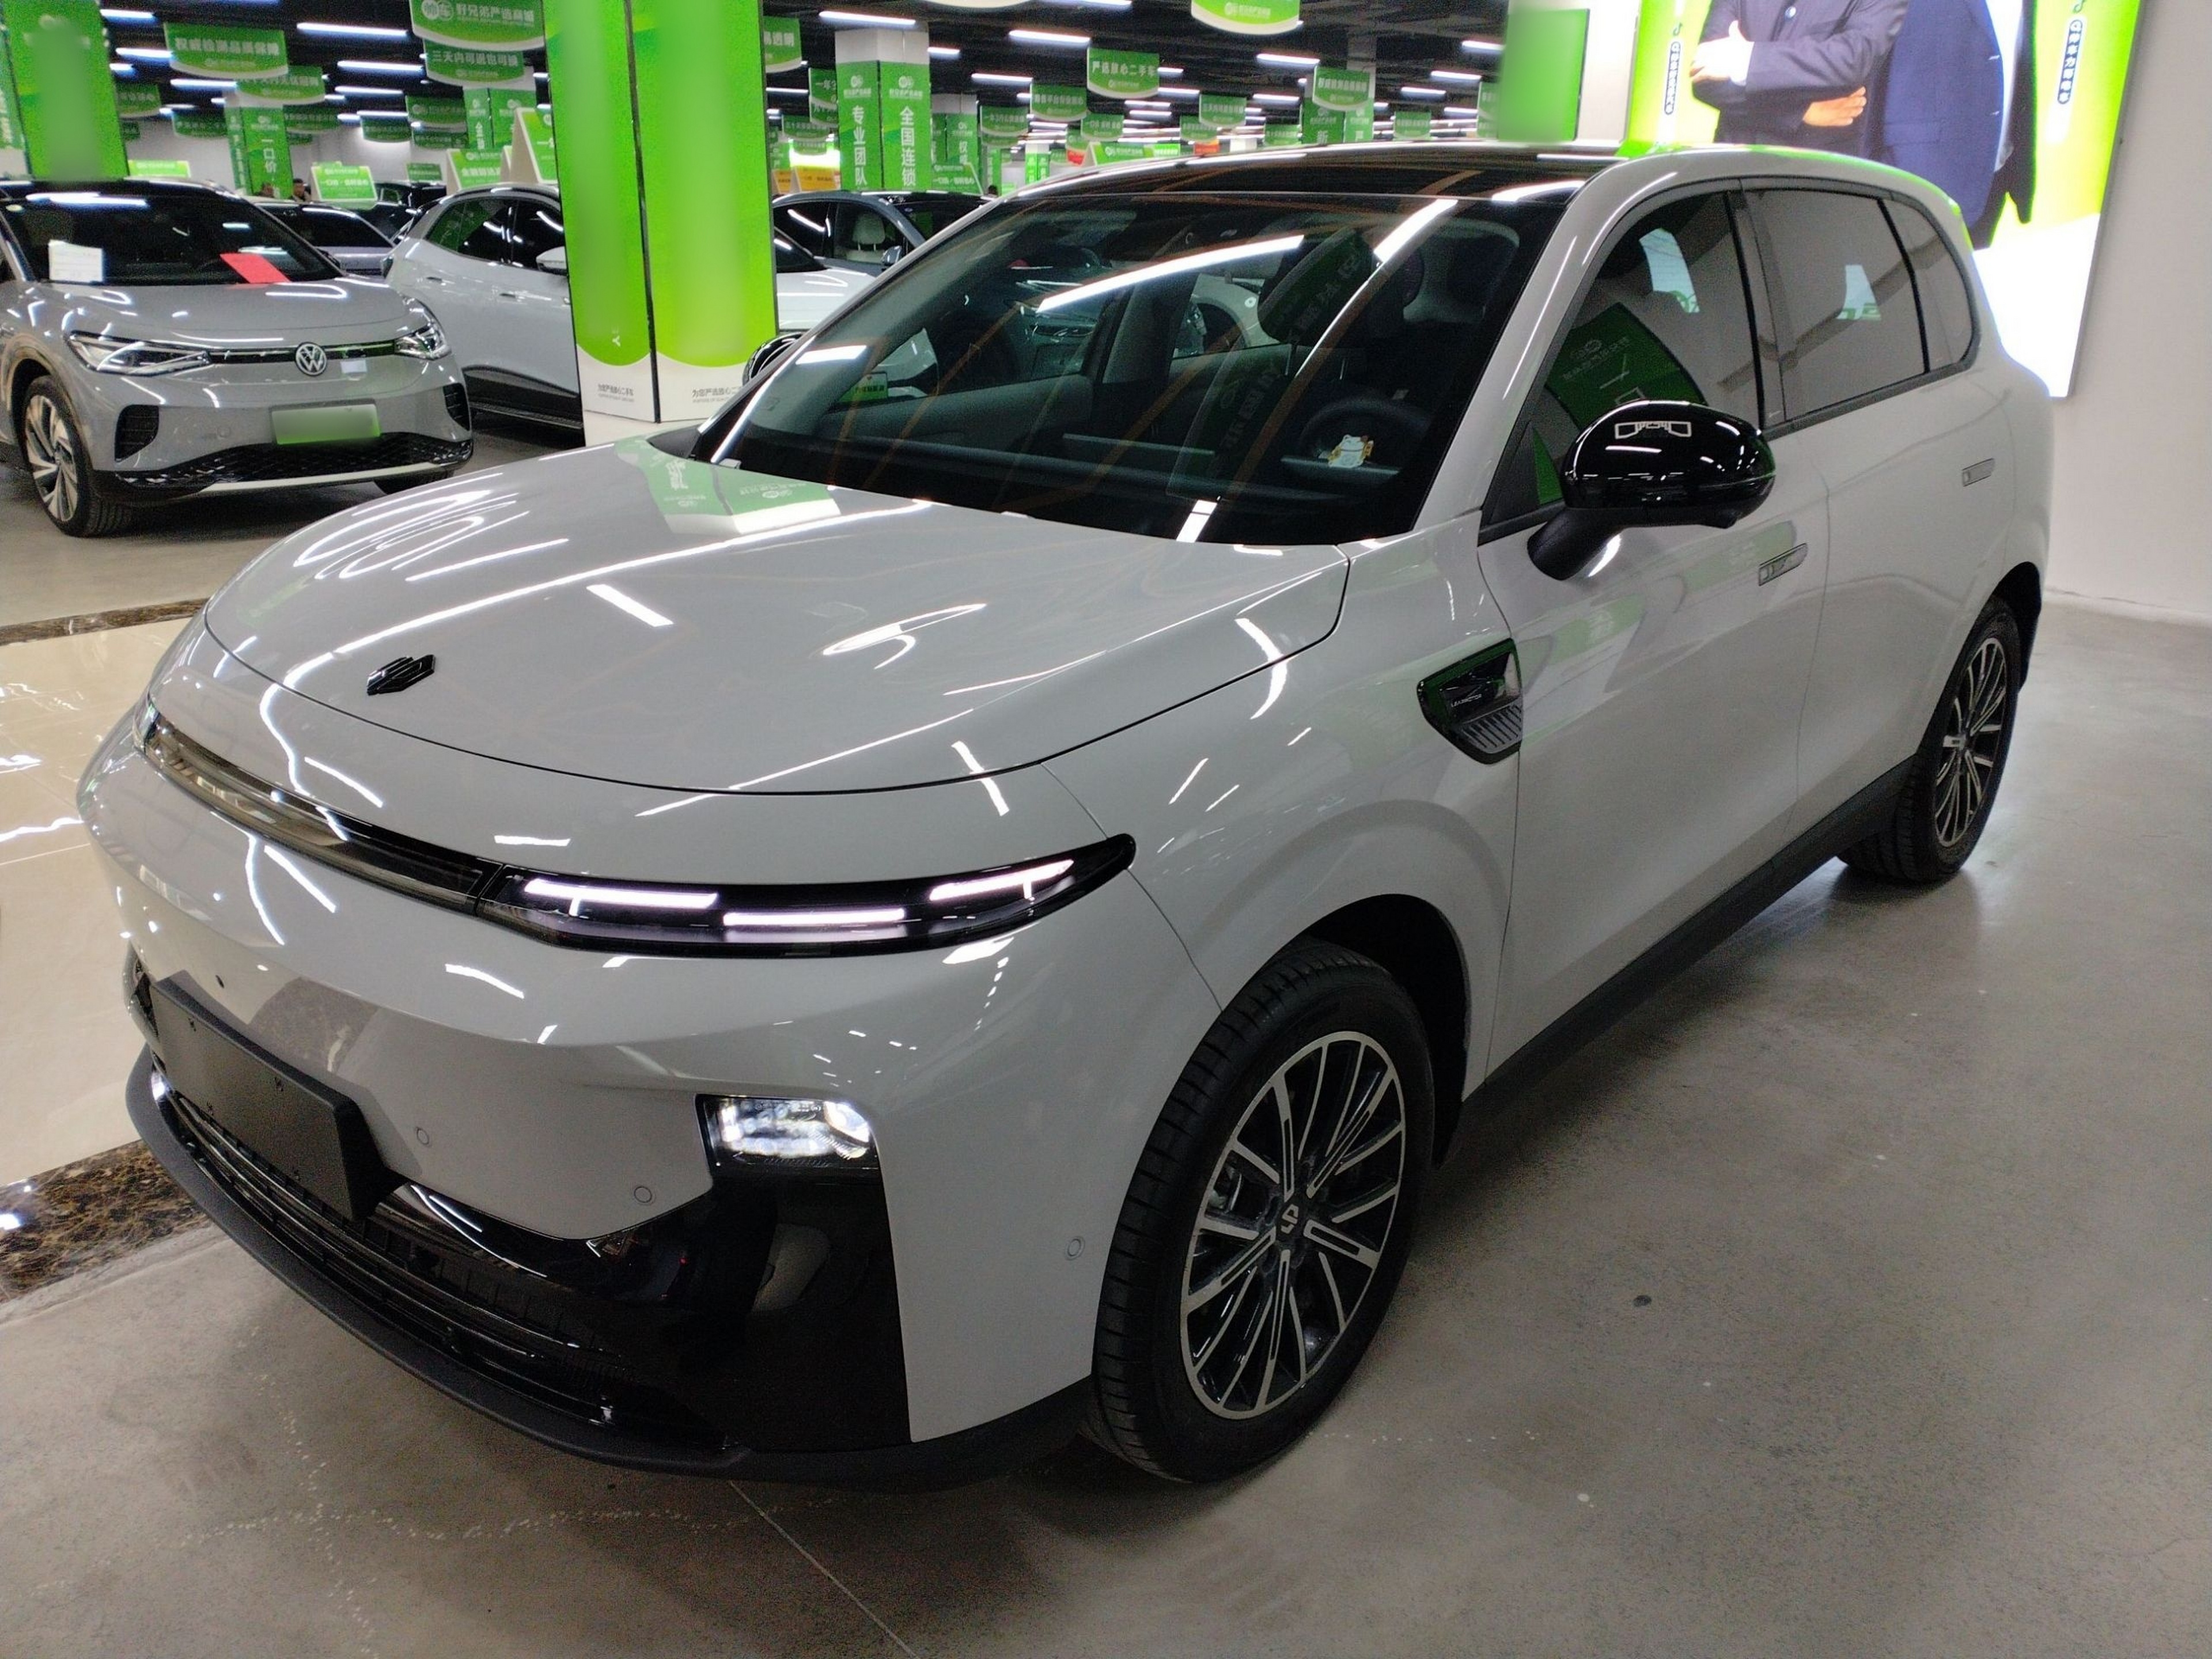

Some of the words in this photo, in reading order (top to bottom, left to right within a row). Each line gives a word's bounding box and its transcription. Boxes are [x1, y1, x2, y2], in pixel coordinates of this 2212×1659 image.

[852, 105, 868, 185] 专业团队
[900, 105, 916, 186] 全国连锁
[692, 387, 741, 397] 为您严选放心二
